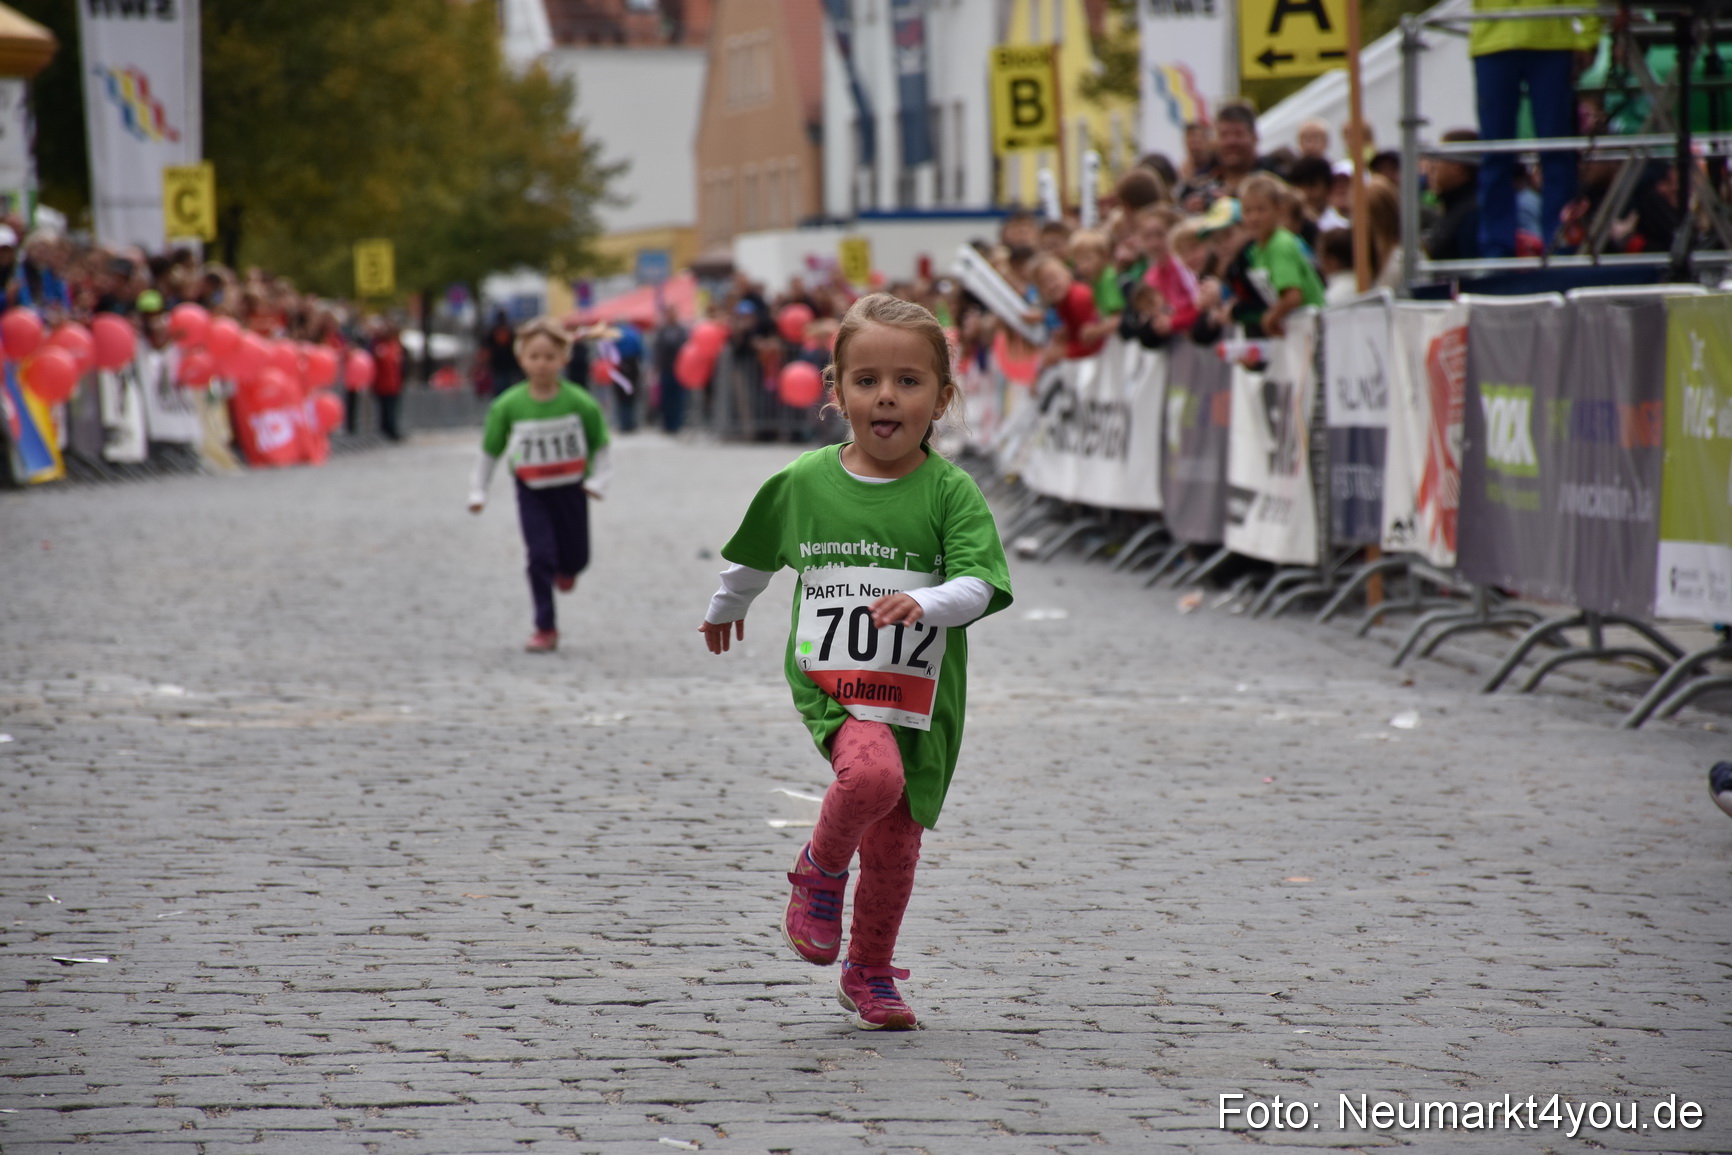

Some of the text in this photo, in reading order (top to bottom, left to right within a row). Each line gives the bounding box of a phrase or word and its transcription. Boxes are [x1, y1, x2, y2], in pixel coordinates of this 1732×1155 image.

[1267, 0, 1332, 34] A
[1010, 78, 1045, 128] B
[173, 187, 200, 224] C
[800, 540, 898, 560] Neumarkter
[806, 583, 903, 600] PARTL Neu
[816, 605, 938, 669] 7012
